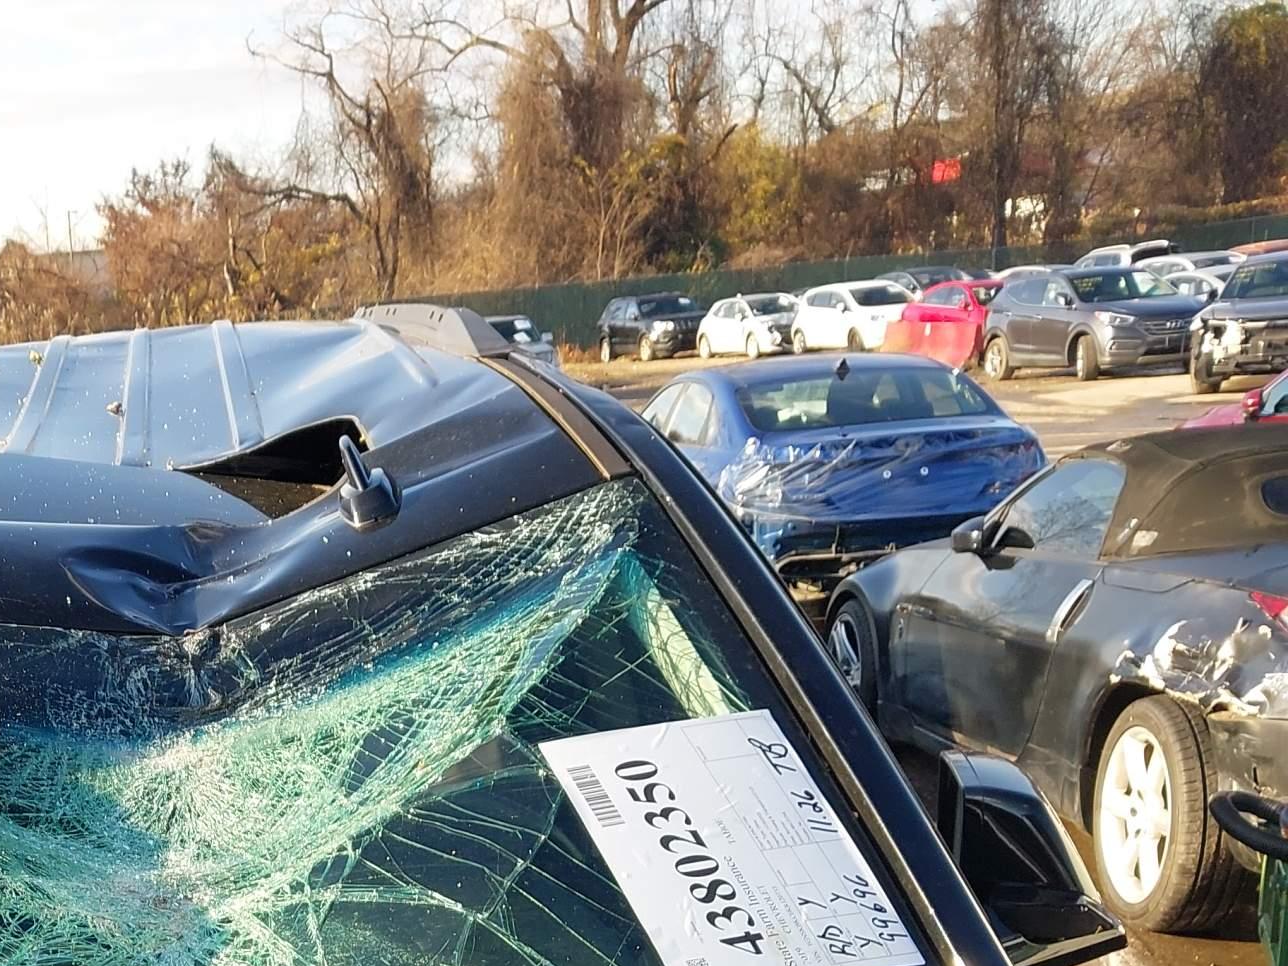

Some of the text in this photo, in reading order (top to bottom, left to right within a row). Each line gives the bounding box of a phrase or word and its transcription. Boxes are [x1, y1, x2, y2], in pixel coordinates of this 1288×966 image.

[791, 790, 838, 834] 11.26
[615, 759, 765, 956] 43802350
[723, 855, 761, 907] Insurance
[752, 908, 780, 938] Farm
[756, 885, 793, 935] CHEVROLET
